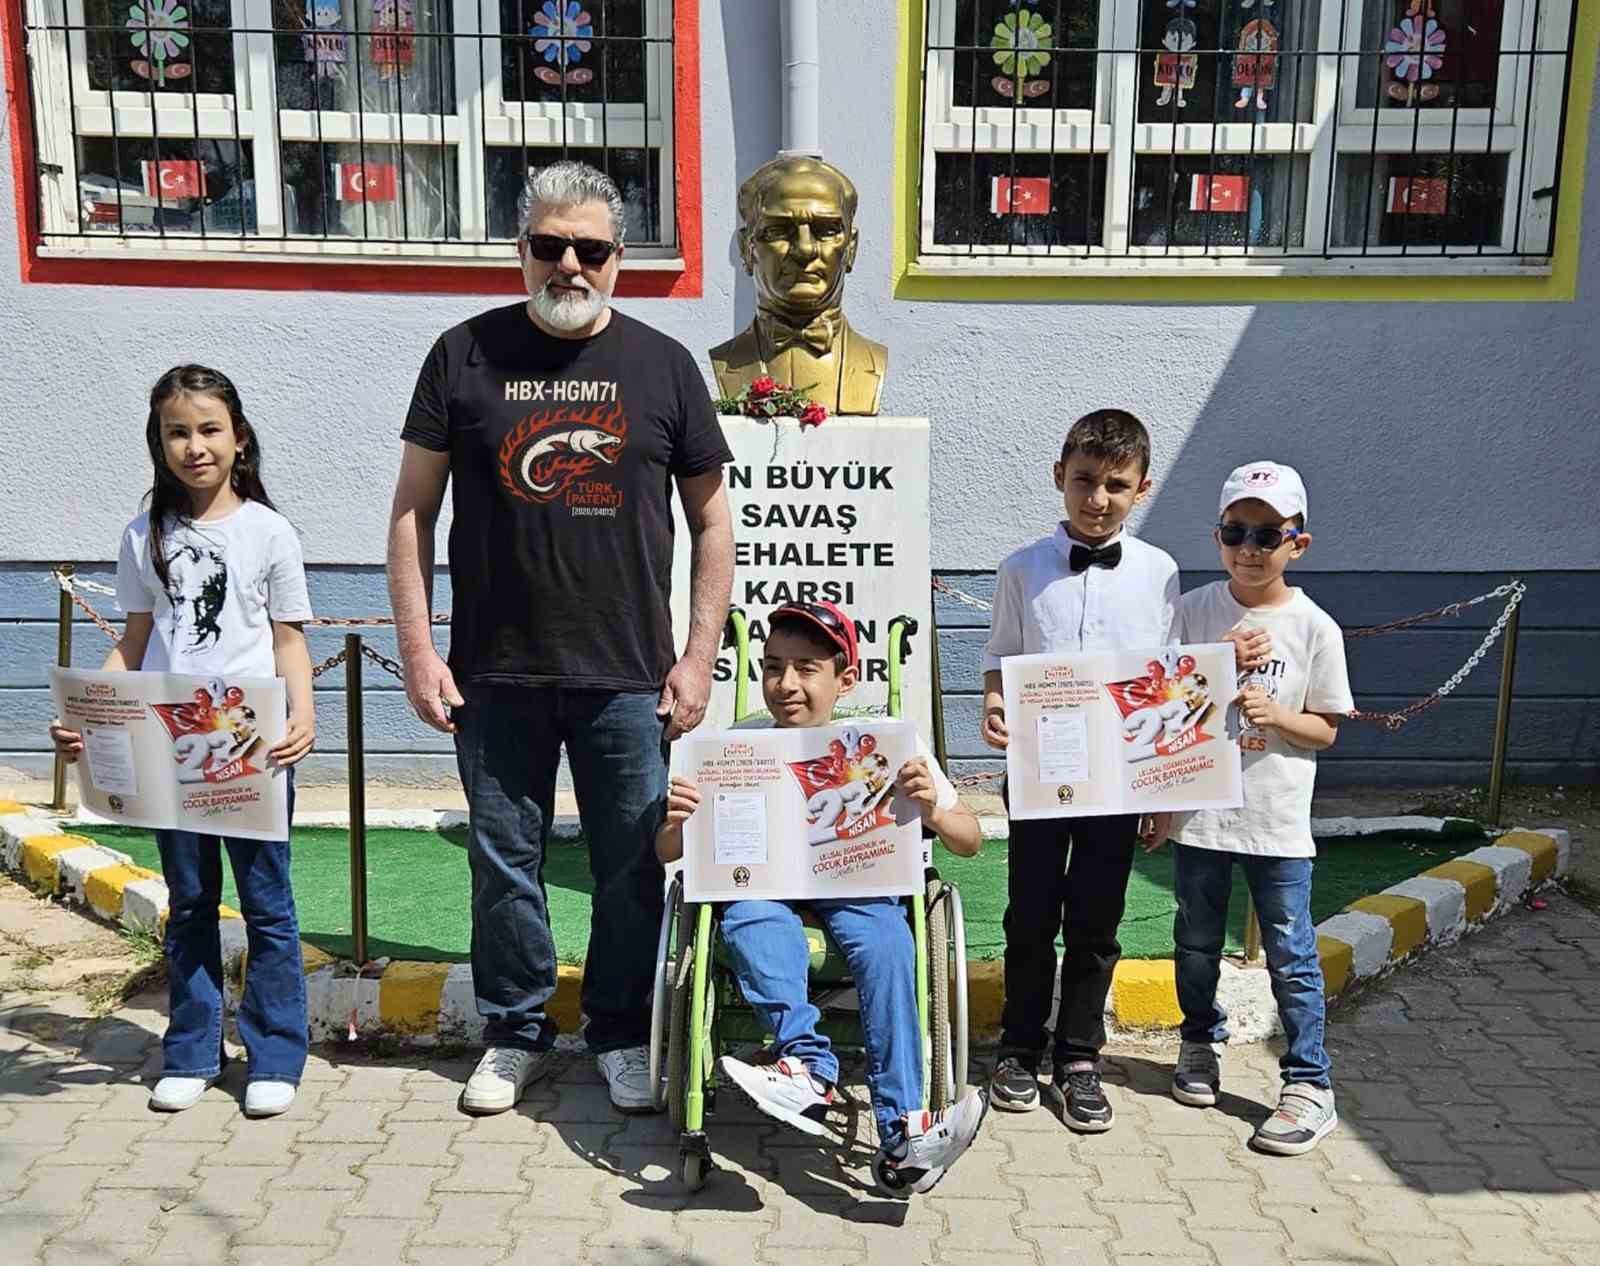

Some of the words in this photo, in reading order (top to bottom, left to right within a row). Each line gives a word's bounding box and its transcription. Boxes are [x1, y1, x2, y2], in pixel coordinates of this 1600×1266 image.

[504, 380, 617, 401] HBX-HGM71
[729, 466, 752, 489] N
[766, 460, 894, 490] BÜYÜK
[741, 503, 858, 535] SAVAŞ
[734, 542, 895, 567] EHALETE
[1257, 658, 1286, 678] UT!
